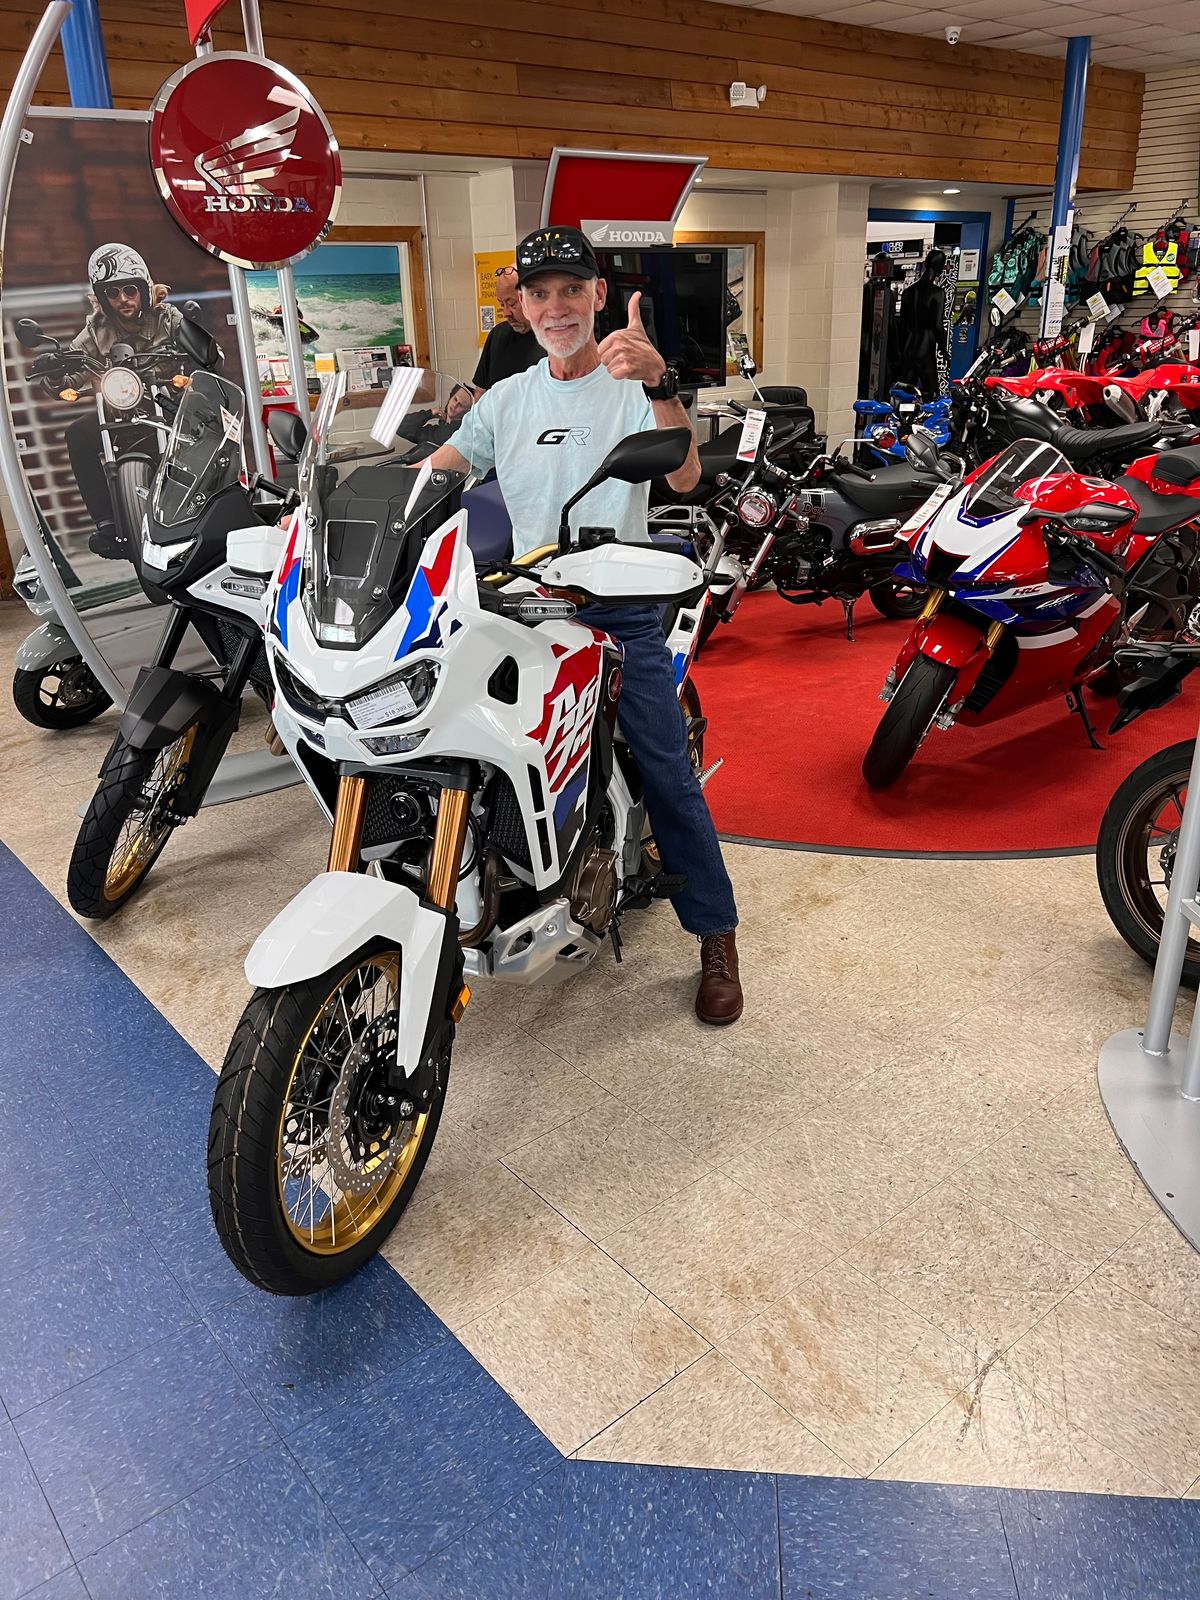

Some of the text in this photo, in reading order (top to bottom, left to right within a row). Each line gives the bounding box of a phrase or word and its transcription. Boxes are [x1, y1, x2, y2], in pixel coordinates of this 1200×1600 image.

[203, 195, 313, 213] HONDA
[608, 230, 666, 242] HONDA
[536, 427, 592, 446] GR
[801, 501, 828, 515] Dax
[1011, 584, 1044, 596] HRC
